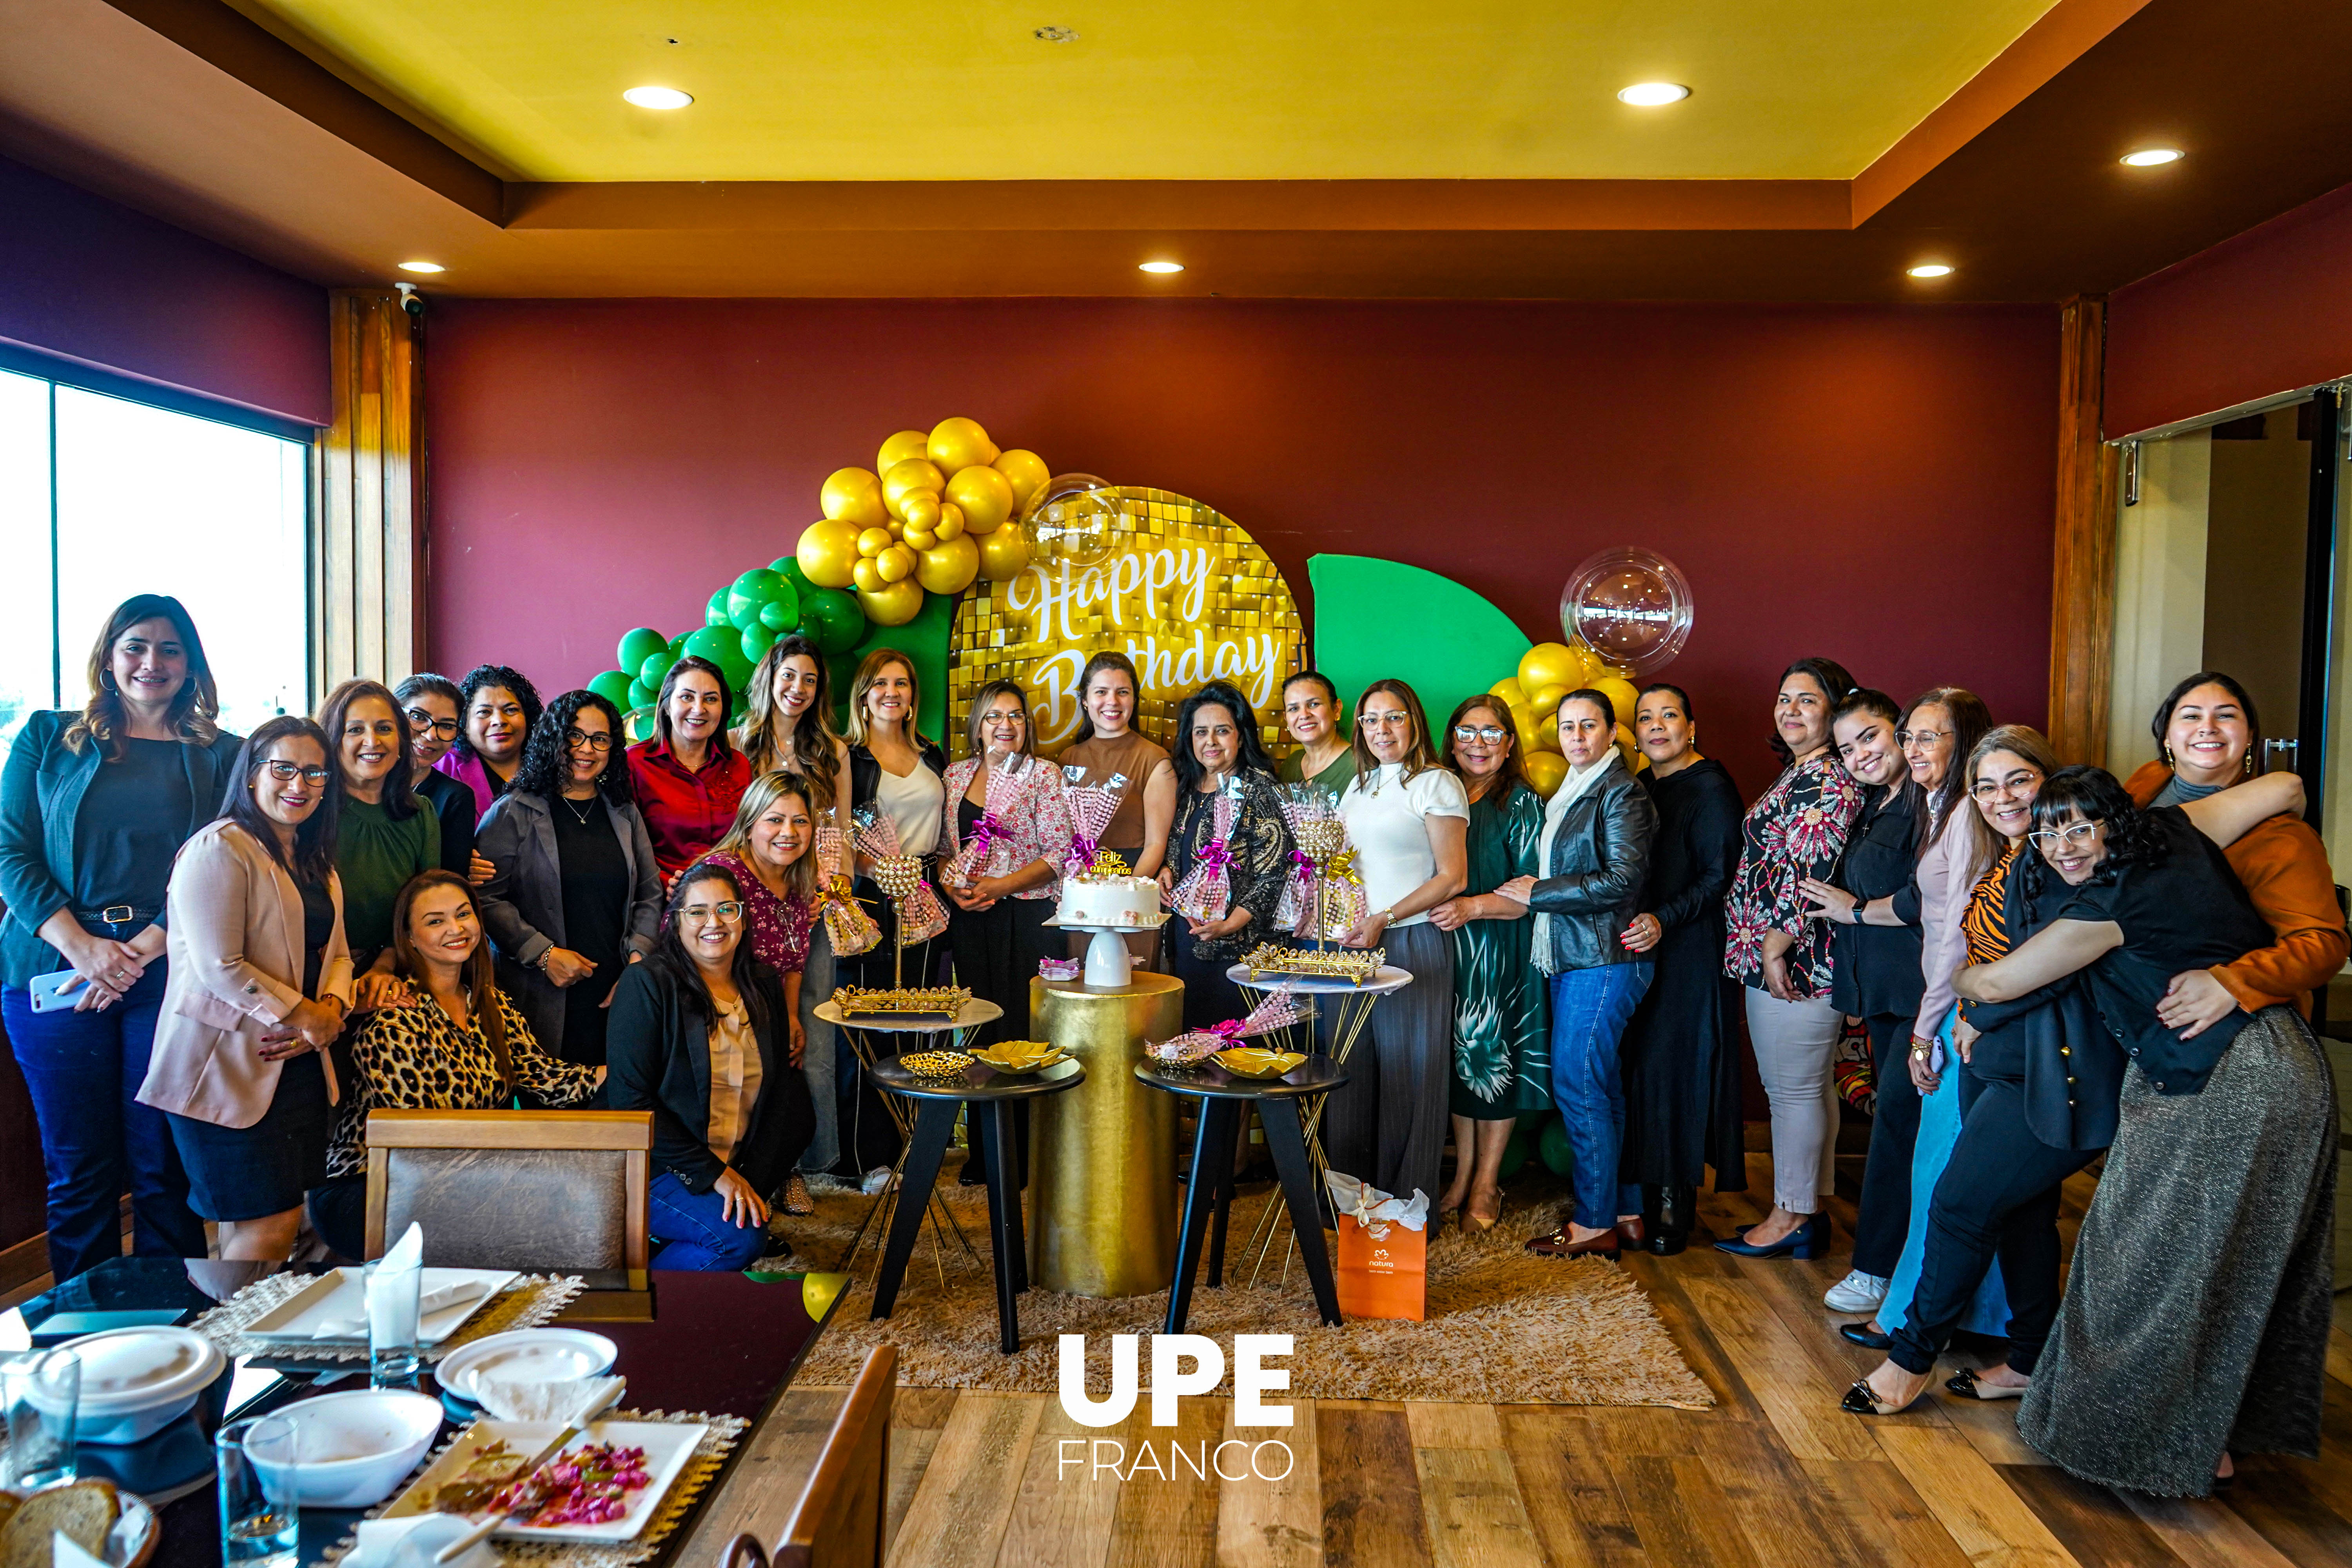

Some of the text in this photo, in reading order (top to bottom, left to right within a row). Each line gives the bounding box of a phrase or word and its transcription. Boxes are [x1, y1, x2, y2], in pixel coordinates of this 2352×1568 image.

[1007, 548, 1216, 642] Happy
[1033, 629, 1281, 744] Bthday
[1100, 851, 1122, 863] Feliz
